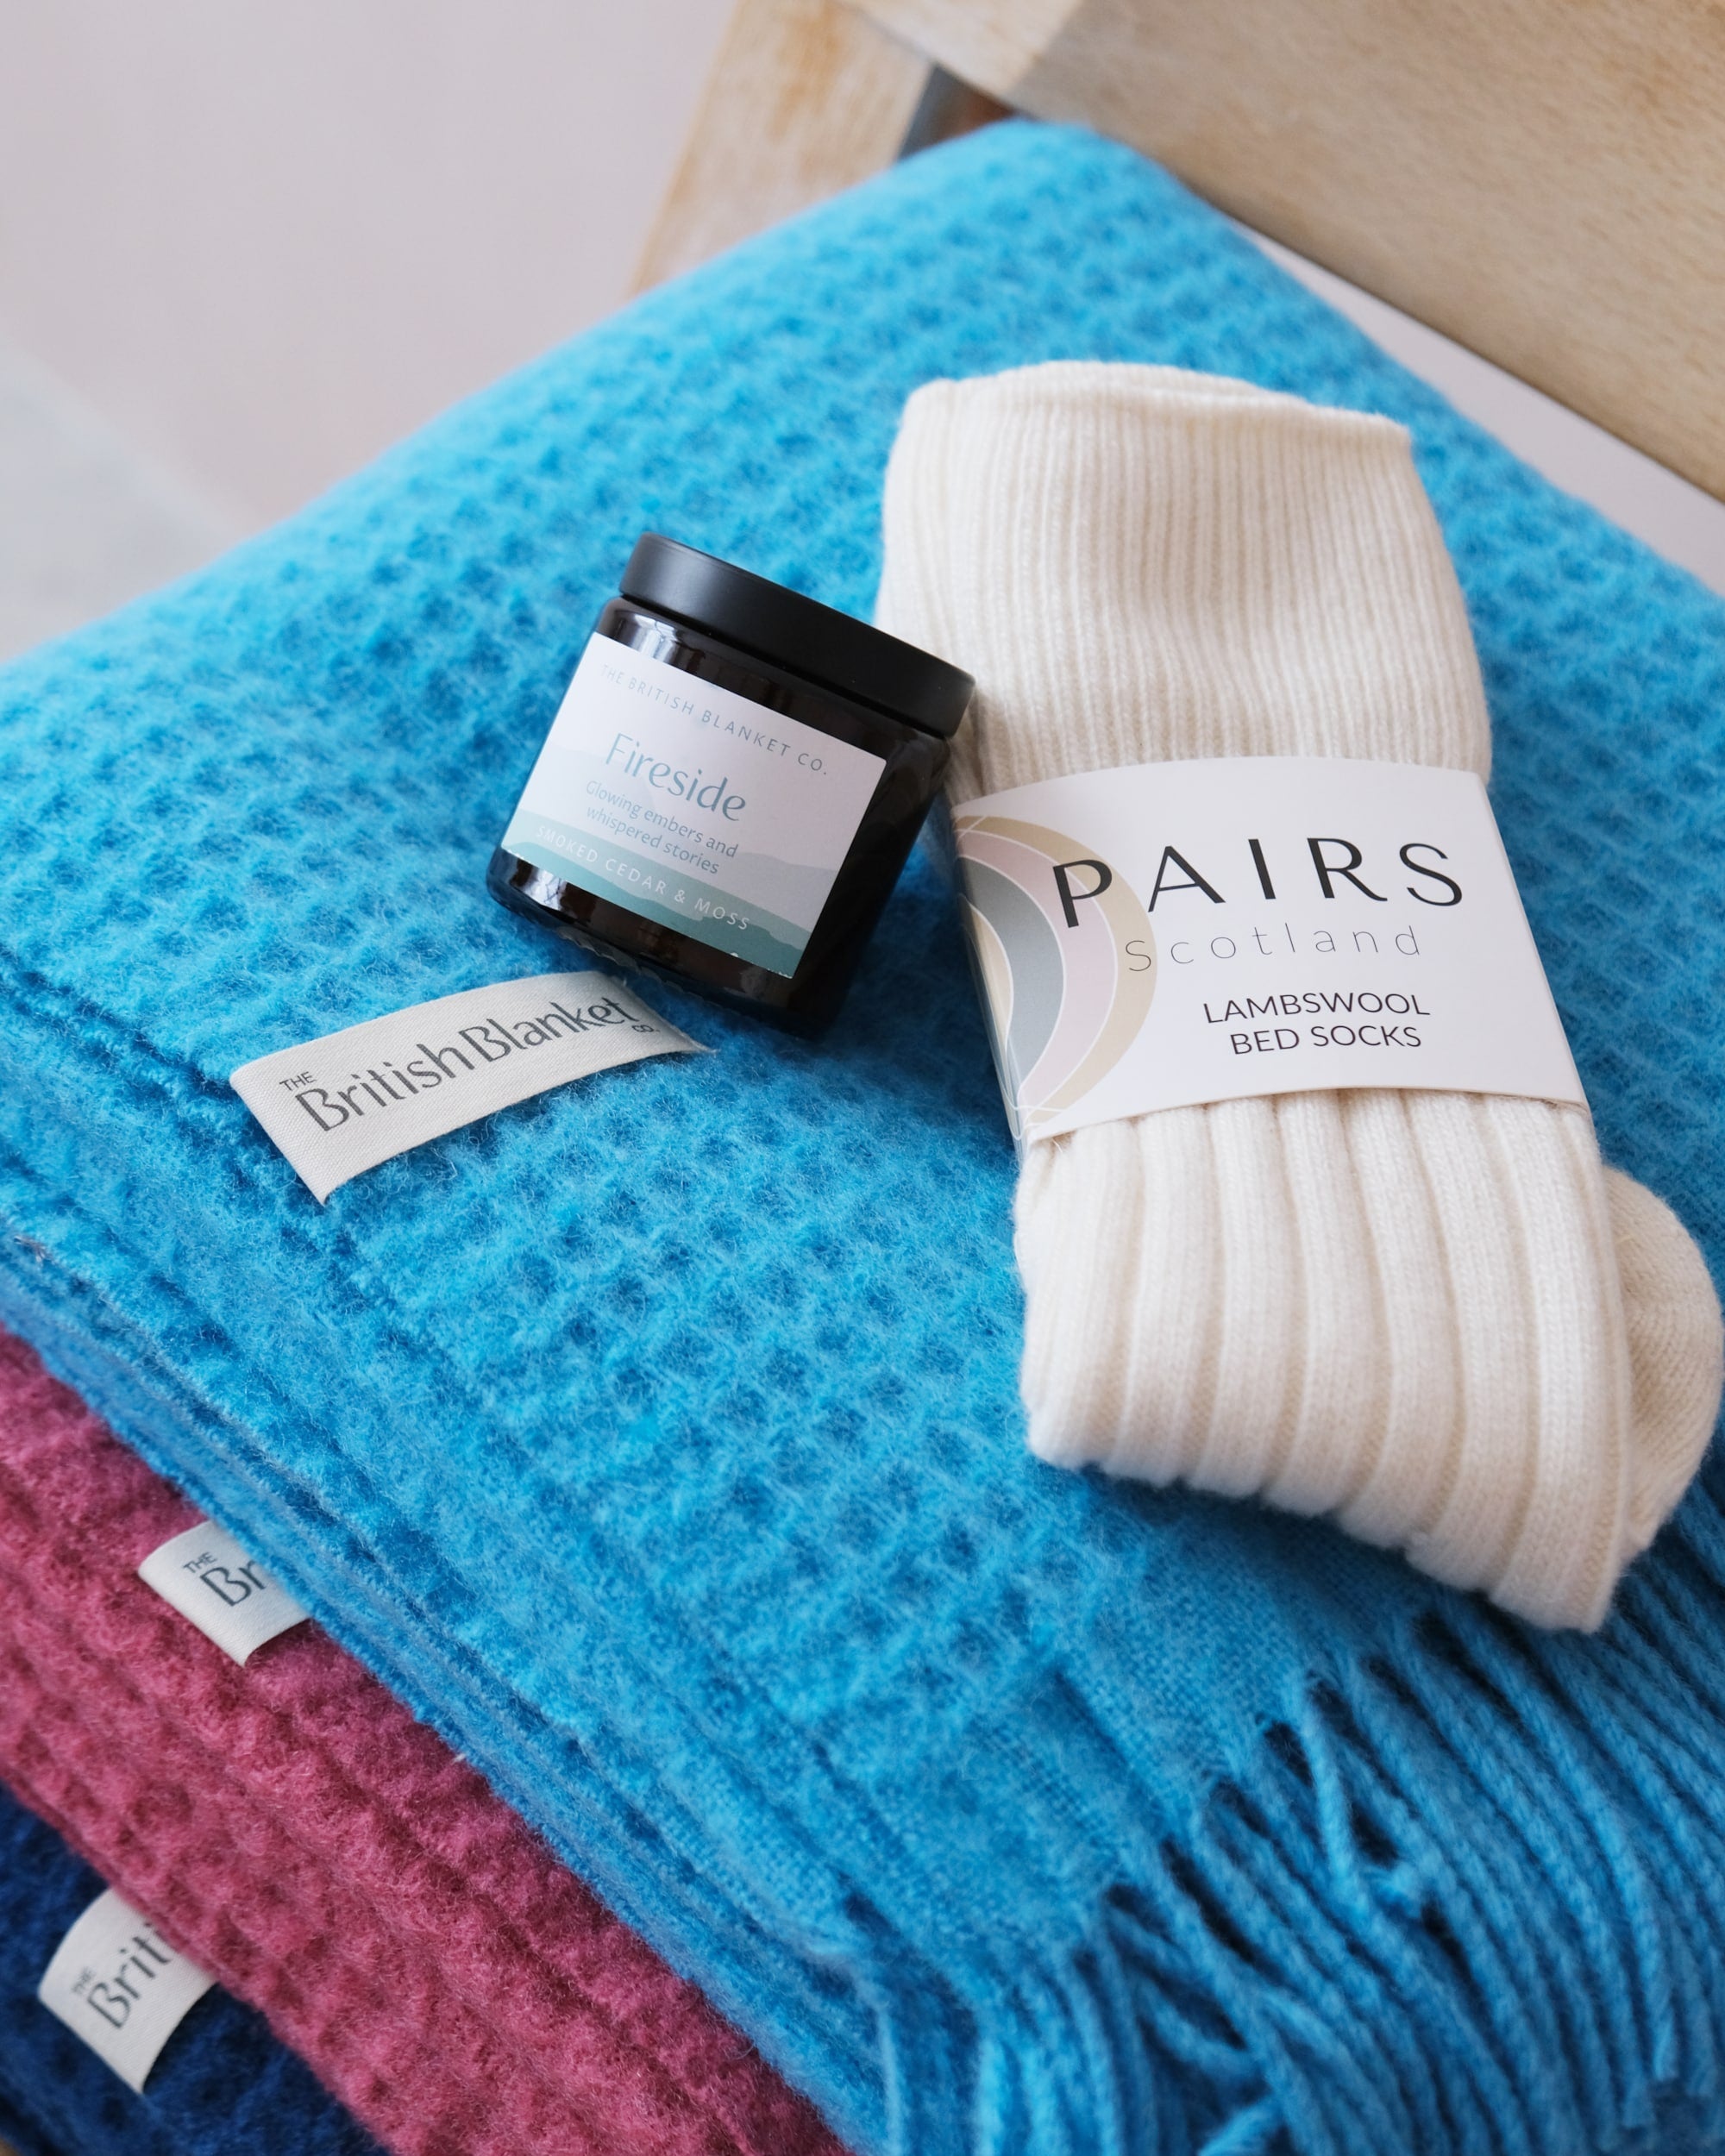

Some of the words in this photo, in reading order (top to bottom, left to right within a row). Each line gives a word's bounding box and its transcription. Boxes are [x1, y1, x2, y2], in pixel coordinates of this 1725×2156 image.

[602, 664, 623, 685] THE
[628, 677, 694, 715] BRITISH
[701, 710, 791, 757] BLANKET
[797, 752, 827, 775] CO.
[605, 732, 746, 821] Fireside
[586, 780, 643, 819] Glowing
[643, 809, 703, 844] embers
[706, 836, 739, 858] and
[586, 805, 662, 848] whispered
[663, 842, 719, 874] stories
[536, 824, 599, 862] SMOKED
[605, 858, 667, 895] CEDAR
[674, 889, 685, 904] &
[693, 897, 750, 931] MOSS
[1052, 837, 1464, 929] PAIRS
[1202, 991, 1431, 1025] LAMBSWOOL
[1229, 1026, 1300, 1056] BED
[1311, 1025, 1422, 1049] SOCKS
[279, 1071, 317, 1092] THE
[183, 1551, 217, 1574] THE
